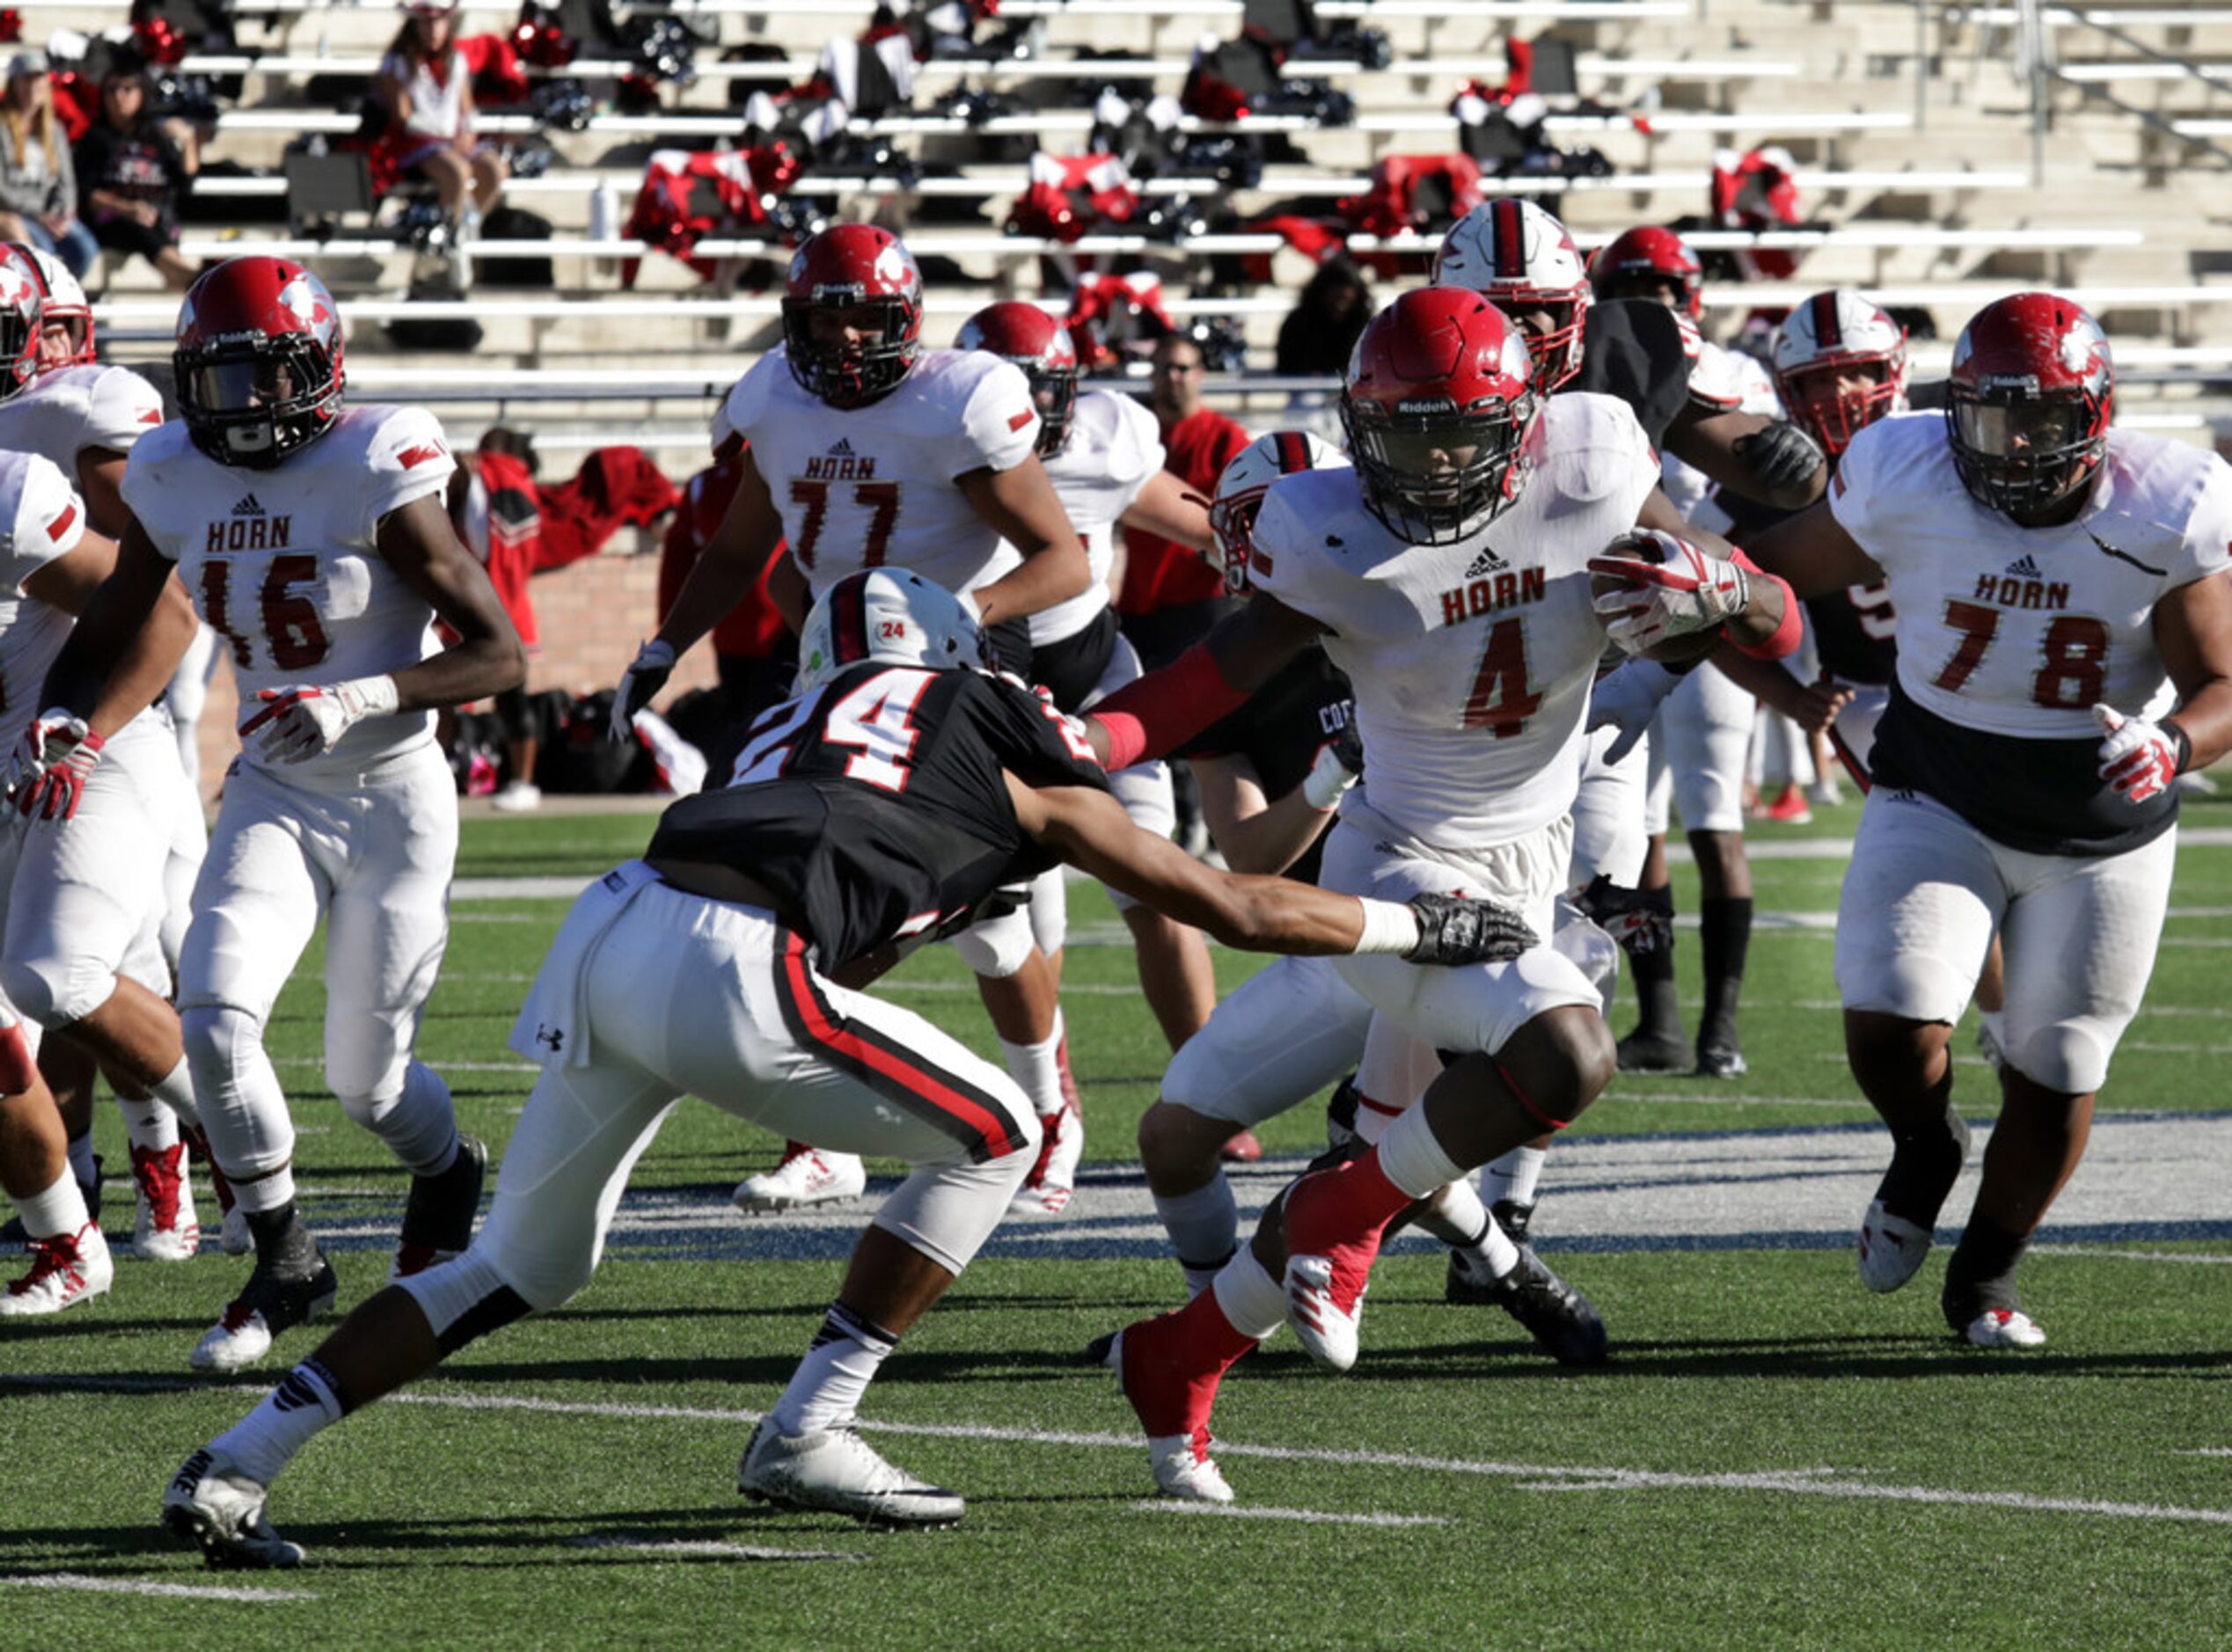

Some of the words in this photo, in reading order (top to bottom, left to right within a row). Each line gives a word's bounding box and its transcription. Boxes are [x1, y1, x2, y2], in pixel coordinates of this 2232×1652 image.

[803, 457, 876, 480] HORN
[207, 515, 291, 553] HORN
[789, 479, 899, 571] 77
[201, 552, 329, 671] 16
[1440, 567, 1546, 627] HORN
[1973, 574, 2069, 610] HORN
[881, 622, 906, 639] 24
[1931, 595, 2111, 710] 78
[1459, 614, 1550, 740] 4
